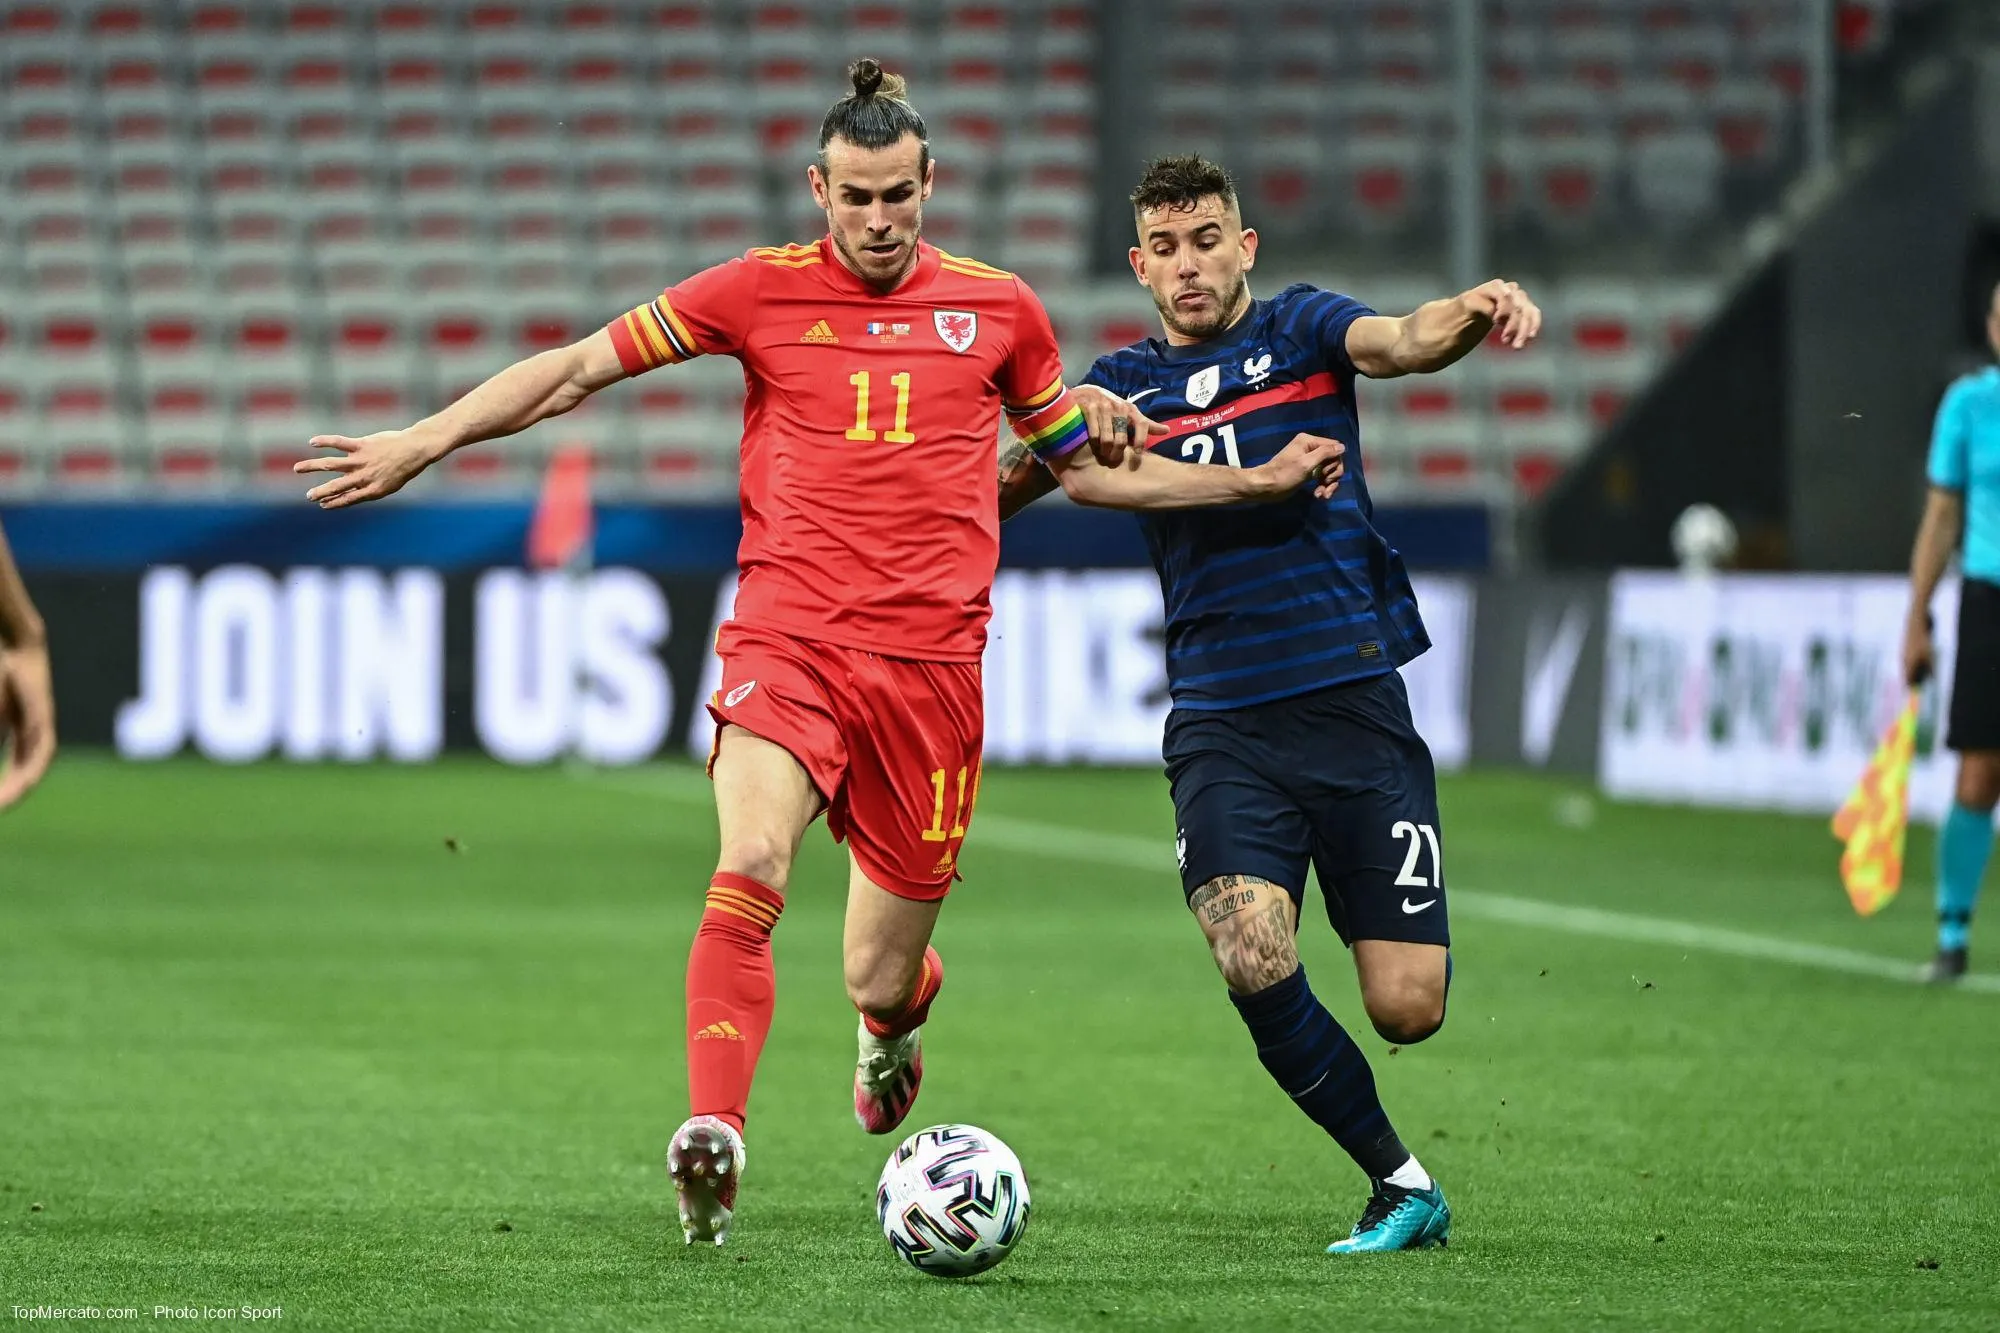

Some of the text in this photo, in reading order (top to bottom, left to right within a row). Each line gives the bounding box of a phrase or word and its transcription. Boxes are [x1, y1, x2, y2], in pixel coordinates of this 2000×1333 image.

[800, 334, 840, 344] adidas
[845, 370, 916, 444] 11
[1181, 423, 1242, 470] 21
[114, 563, 445, 762] JOIN
[473, 564, 673, 764] US
[921, 766, 968, 842] 11
[1391, 820, 1441, 889] 21
